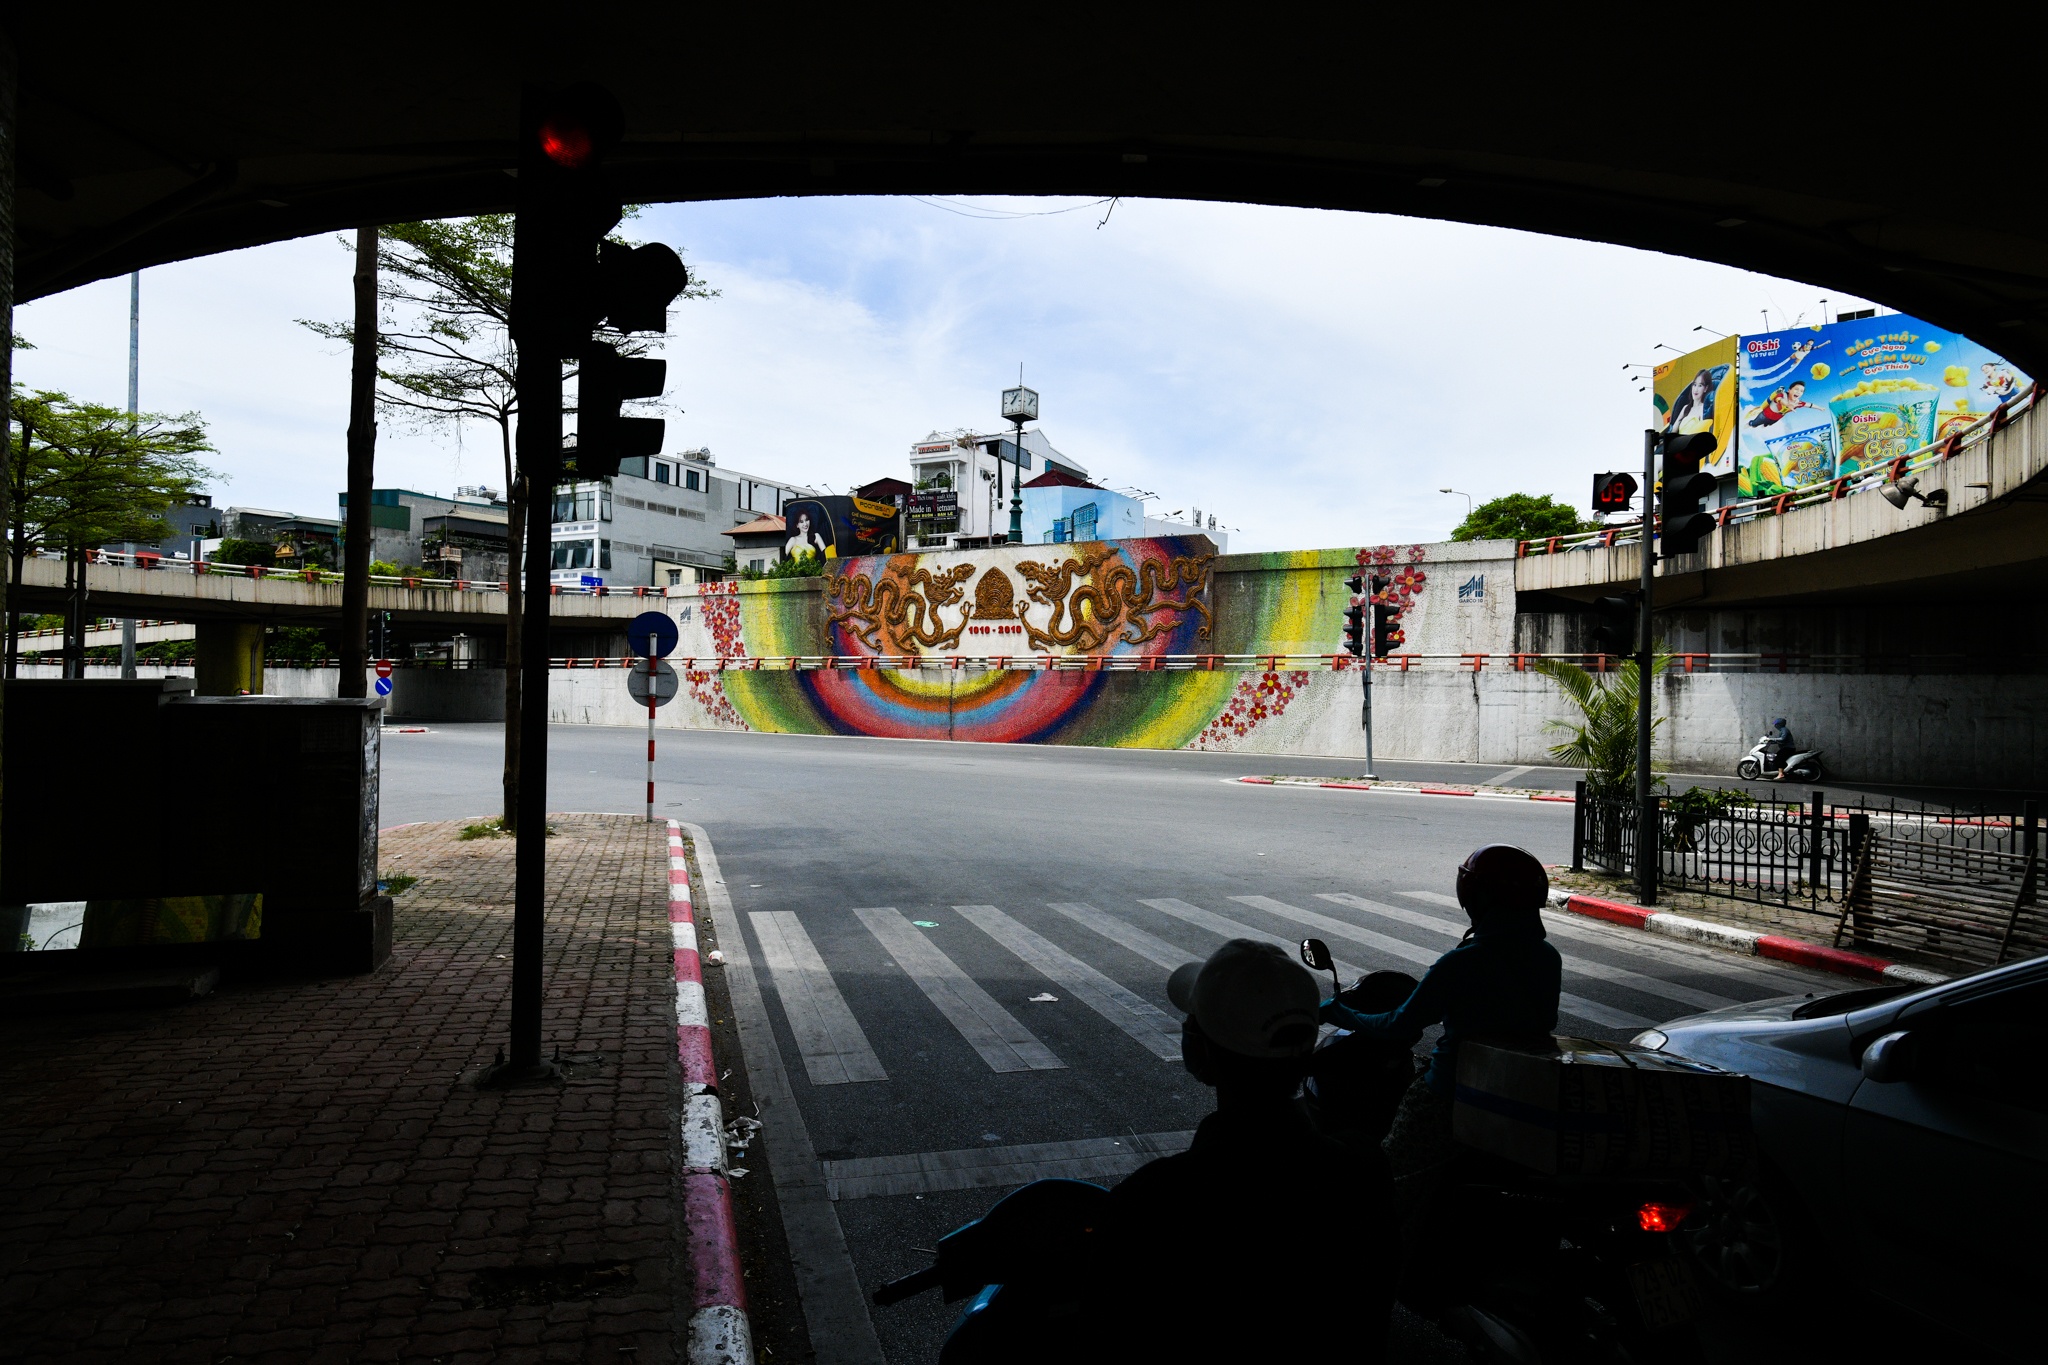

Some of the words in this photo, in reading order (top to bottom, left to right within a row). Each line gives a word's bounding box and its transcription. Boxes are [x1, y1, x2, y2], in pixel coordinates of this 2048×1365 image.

[1877, 331, 1919, 344] THẬT
[1747, 338, 1780, 353] Oishi
[1881, 344, 1907, 352] Ngon
[1901, 353, 1926, 365] VUI
[1853, 414, 1877, 423] Oishi
[1852, 422, 1919, 444] Snack
[1790, 446, 1824, 460] Snack
[1601, 482, 1624, 502] 09
[909, 505, 924, 513] Made
[925, 504, 931, 512] in
[969, 626, 990, 634] 1010
[998, 625, 1022, 634] 2010
[1644, 1286, 1702, 1326] 254.18
